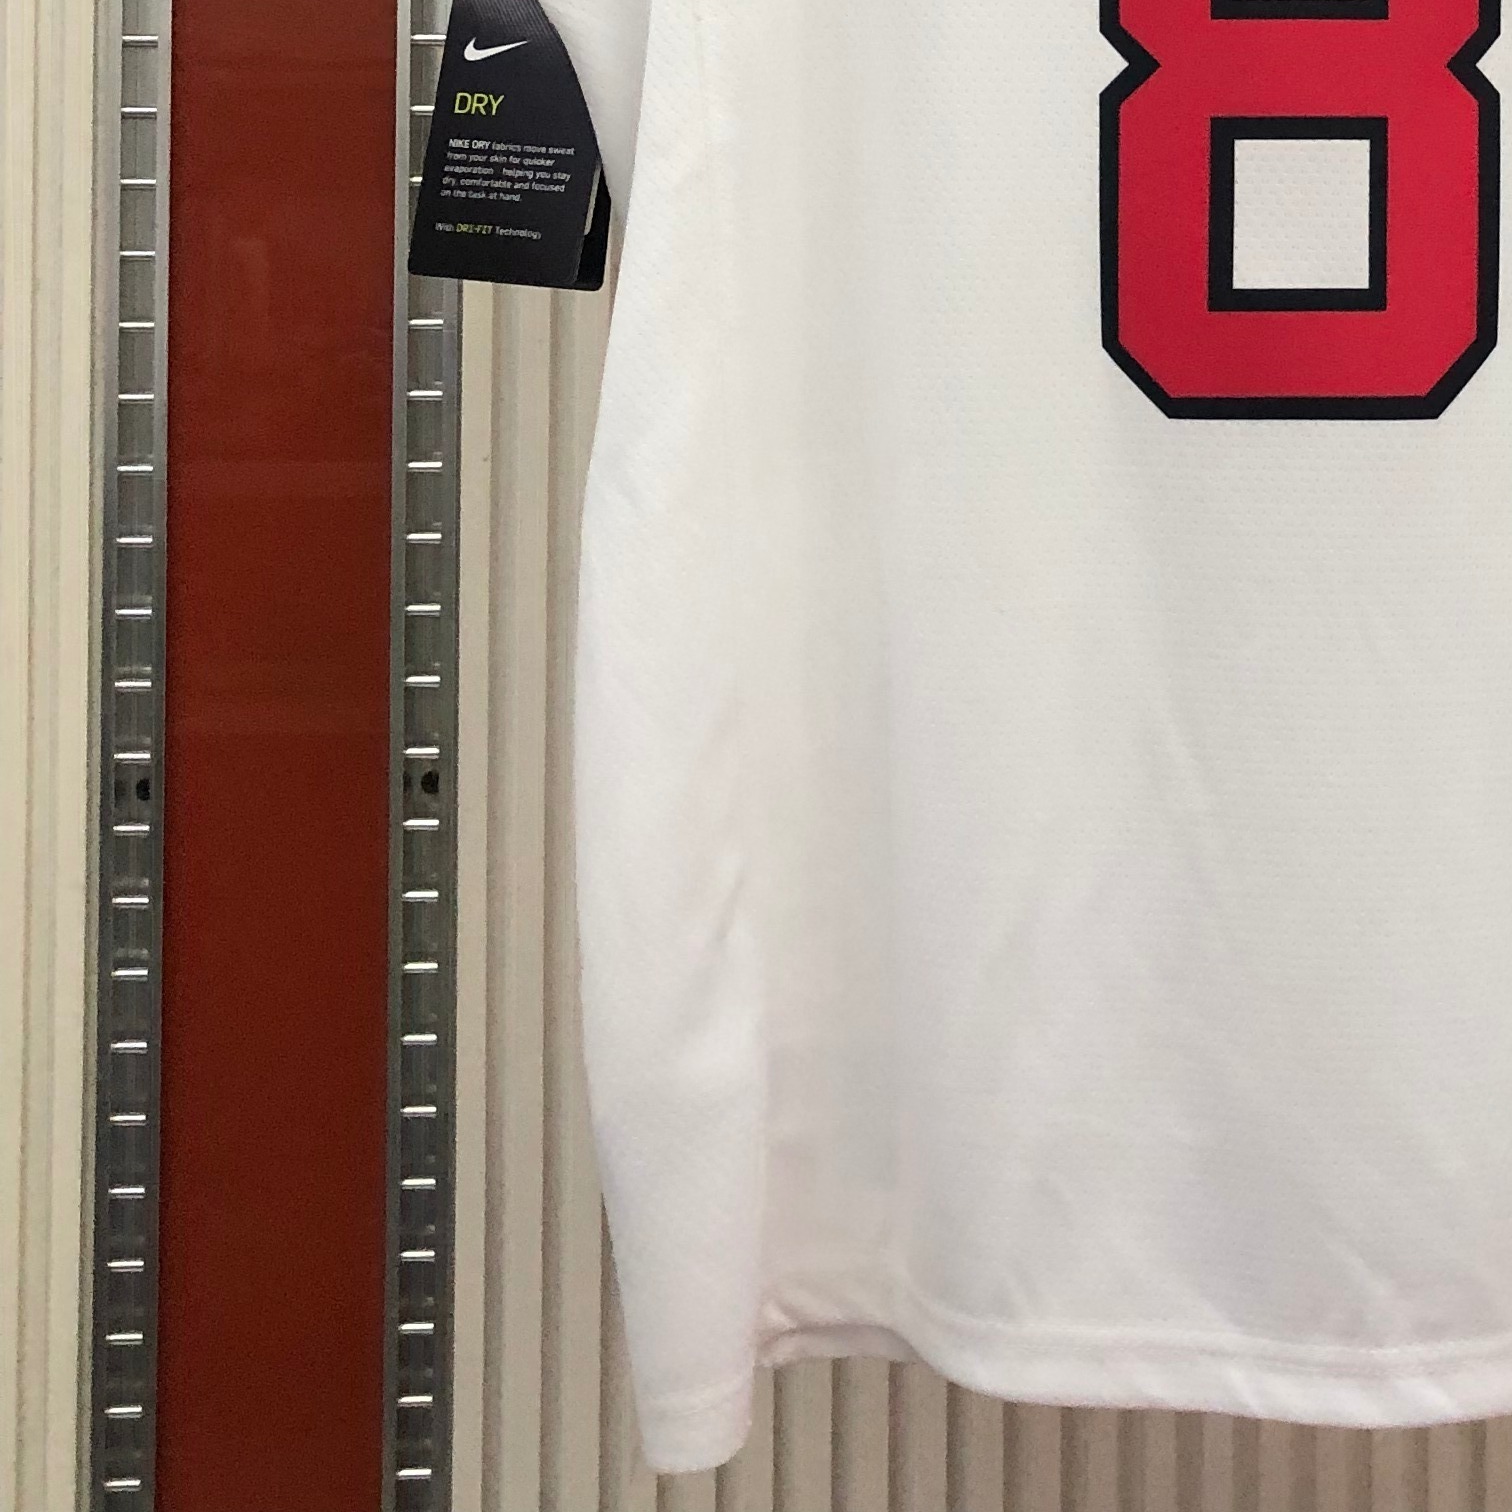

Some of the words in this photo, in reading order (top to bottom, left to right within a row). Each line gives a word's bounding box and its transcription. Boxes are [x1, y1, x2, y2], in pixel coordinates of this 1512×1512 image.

[453, 91, 505, 116] DRY
[448, 138, 470, 149] NIKE
[471, 139, 491, 150] DRY
